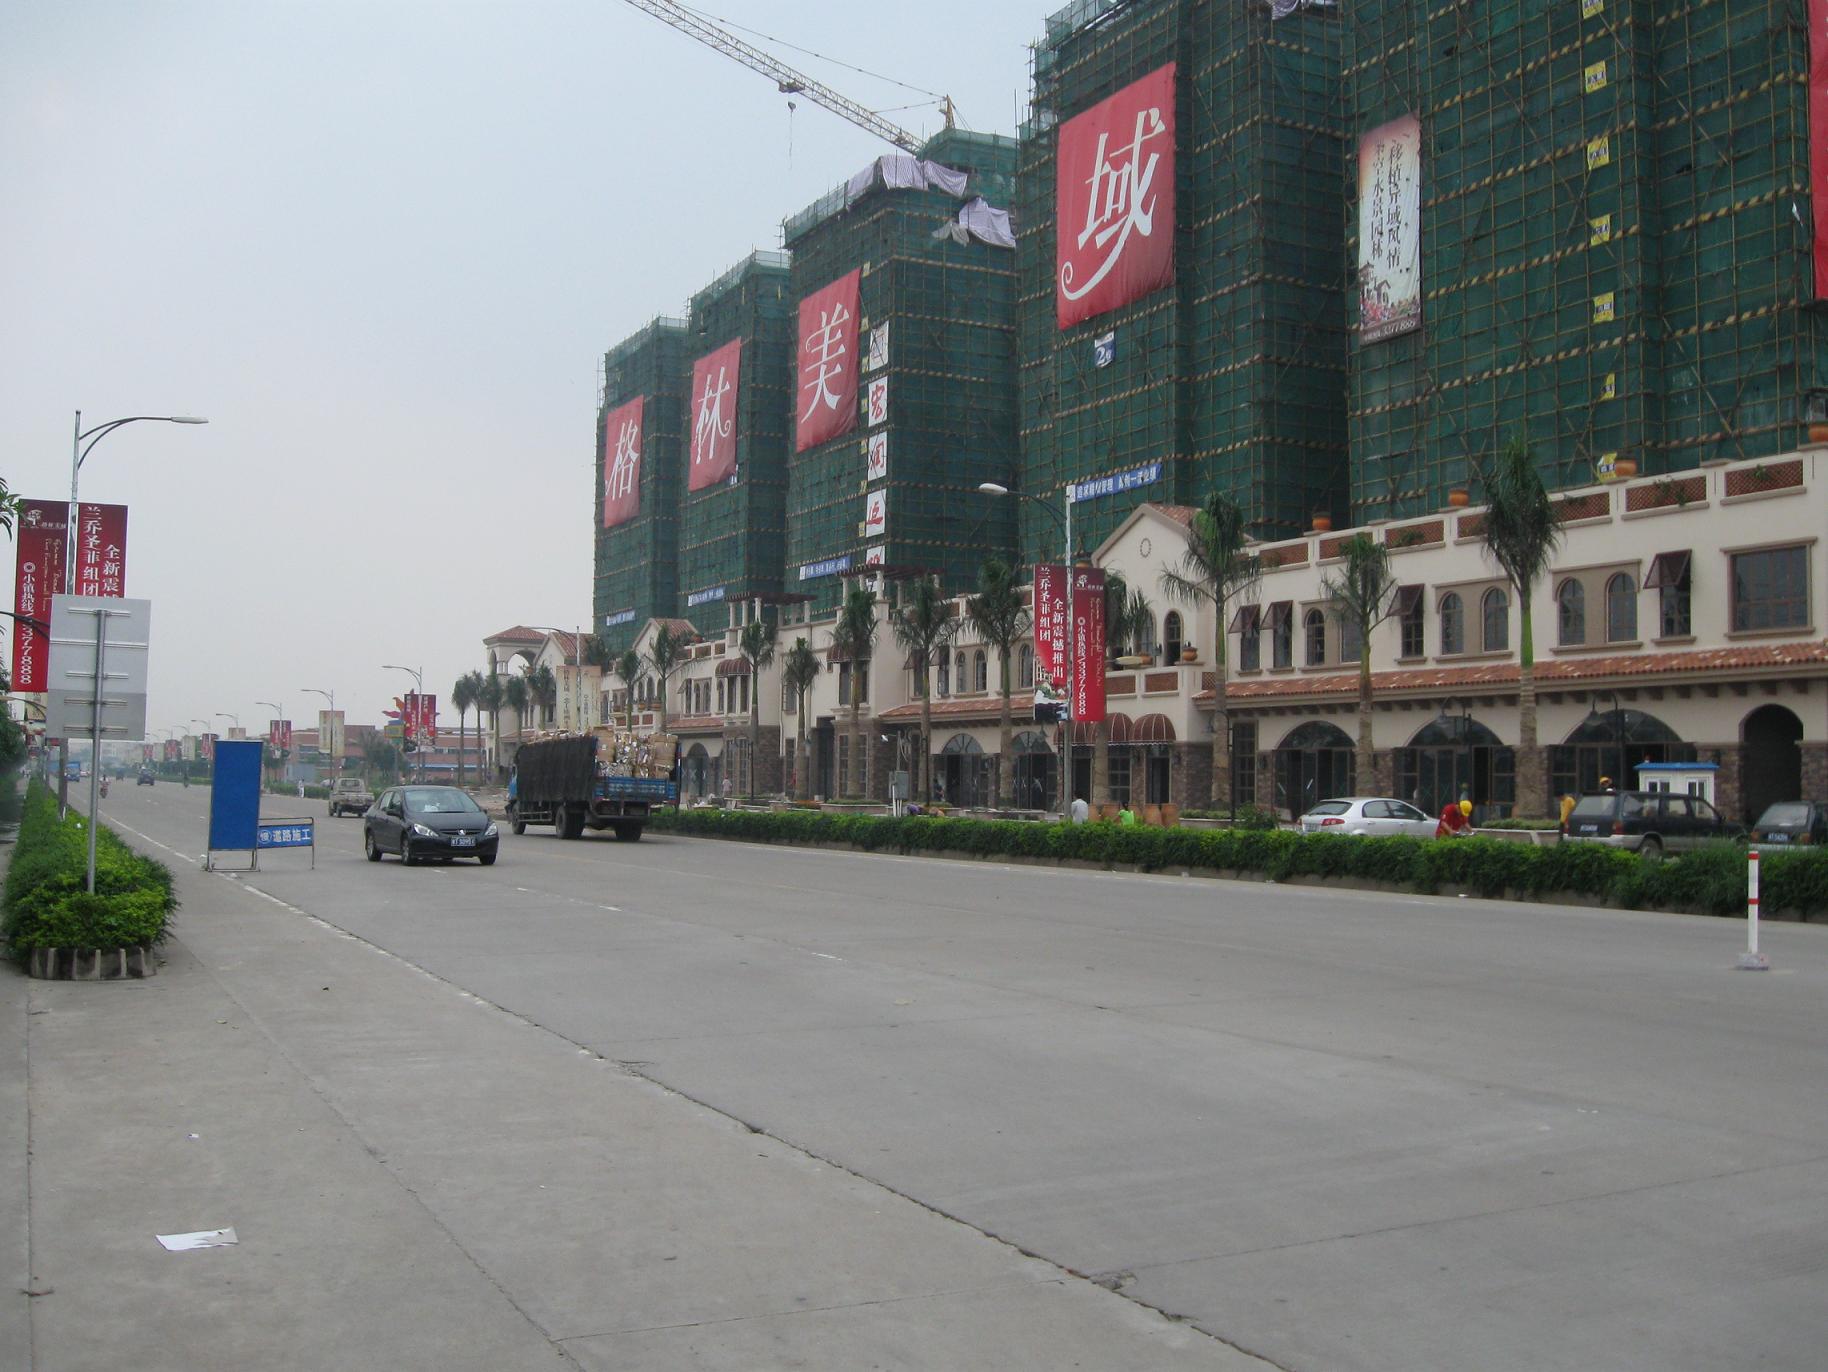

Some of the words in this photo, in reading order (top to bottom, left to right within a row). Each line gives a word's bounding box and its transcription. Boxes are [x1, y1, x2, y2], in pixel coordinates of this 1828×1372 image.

[1061, 108, 1166, 300] 域
[801, 302, 850, 423] 美
[695, 366, 732, 465] 林
[604, 418, 640, 500] 格
[83, 506, 102, 595] 兰乔圣菲组团
[102, 544, 120, 597] 全新震
[1052, 598, 1065, 678] 全新震撼推出
[272, 828, 311, 842] 道路施工
